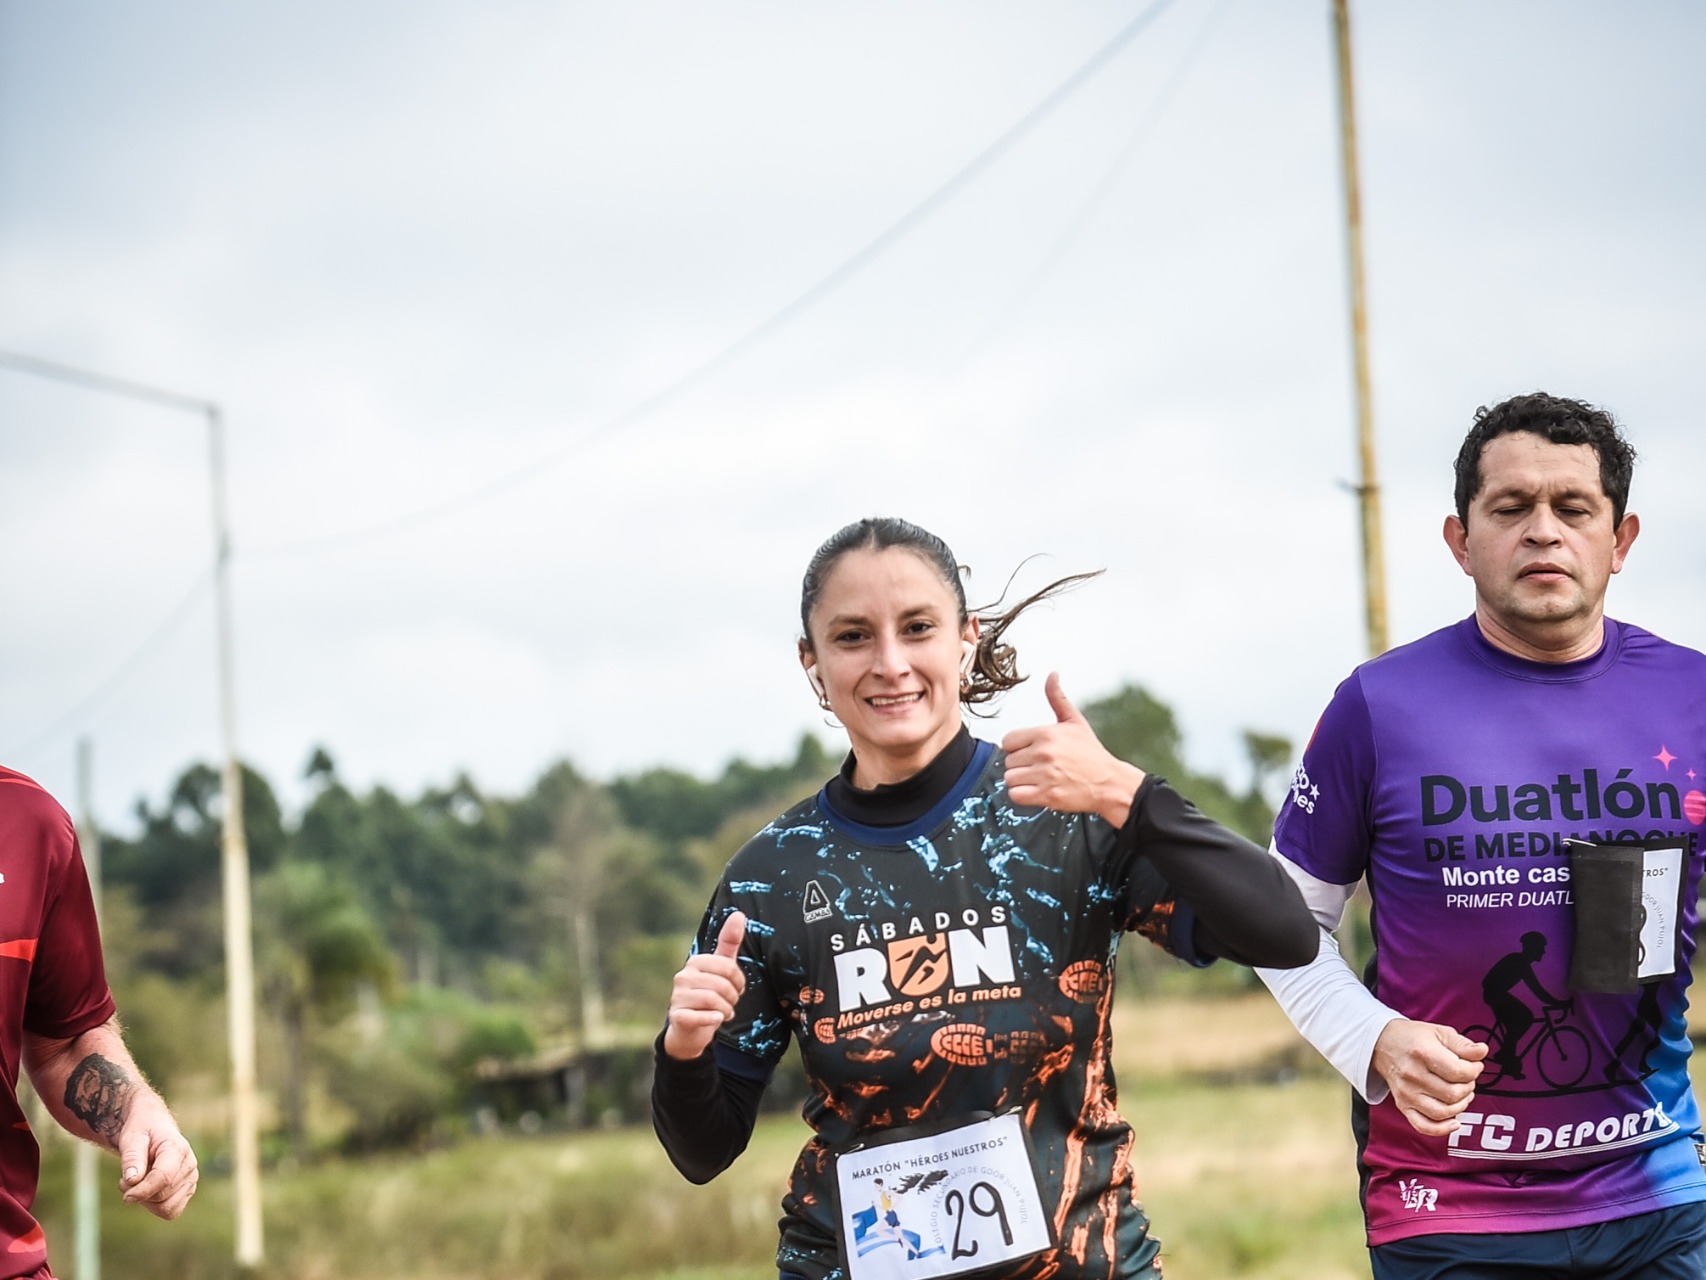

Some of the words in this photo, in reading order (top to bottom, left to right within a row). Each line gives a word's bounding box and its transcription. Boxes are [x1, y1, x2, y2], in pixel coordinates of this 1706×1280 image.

[1420, 768, 1682, 827] Duatlón
[1423, 834, 1466, 863] DE
[1442, 864, 1520, 887] Monte
[1528, 866, 1571, 884] cas
[1446, 892, 1514, 908] PRIMER
[1518, 890, 1575, 907] DUATL
[830, 906, 1006, 951] SÁBADOS
[833, 925, 1016, 1012] RUN
[837, 1001, 914, 1029] Moverse
[919, 995, 942, 1010] es
[947, 988, 966, 1005] la
[972, 985, 1022, 1001] meta
[852, 1161, 901, 1180] MARATÓN
[904, 1152, 949, 1168] "HÉROES
[951, 1136, 1008, 1159] NUESTROS"
[945, 1181, 1014, 1261] 29
